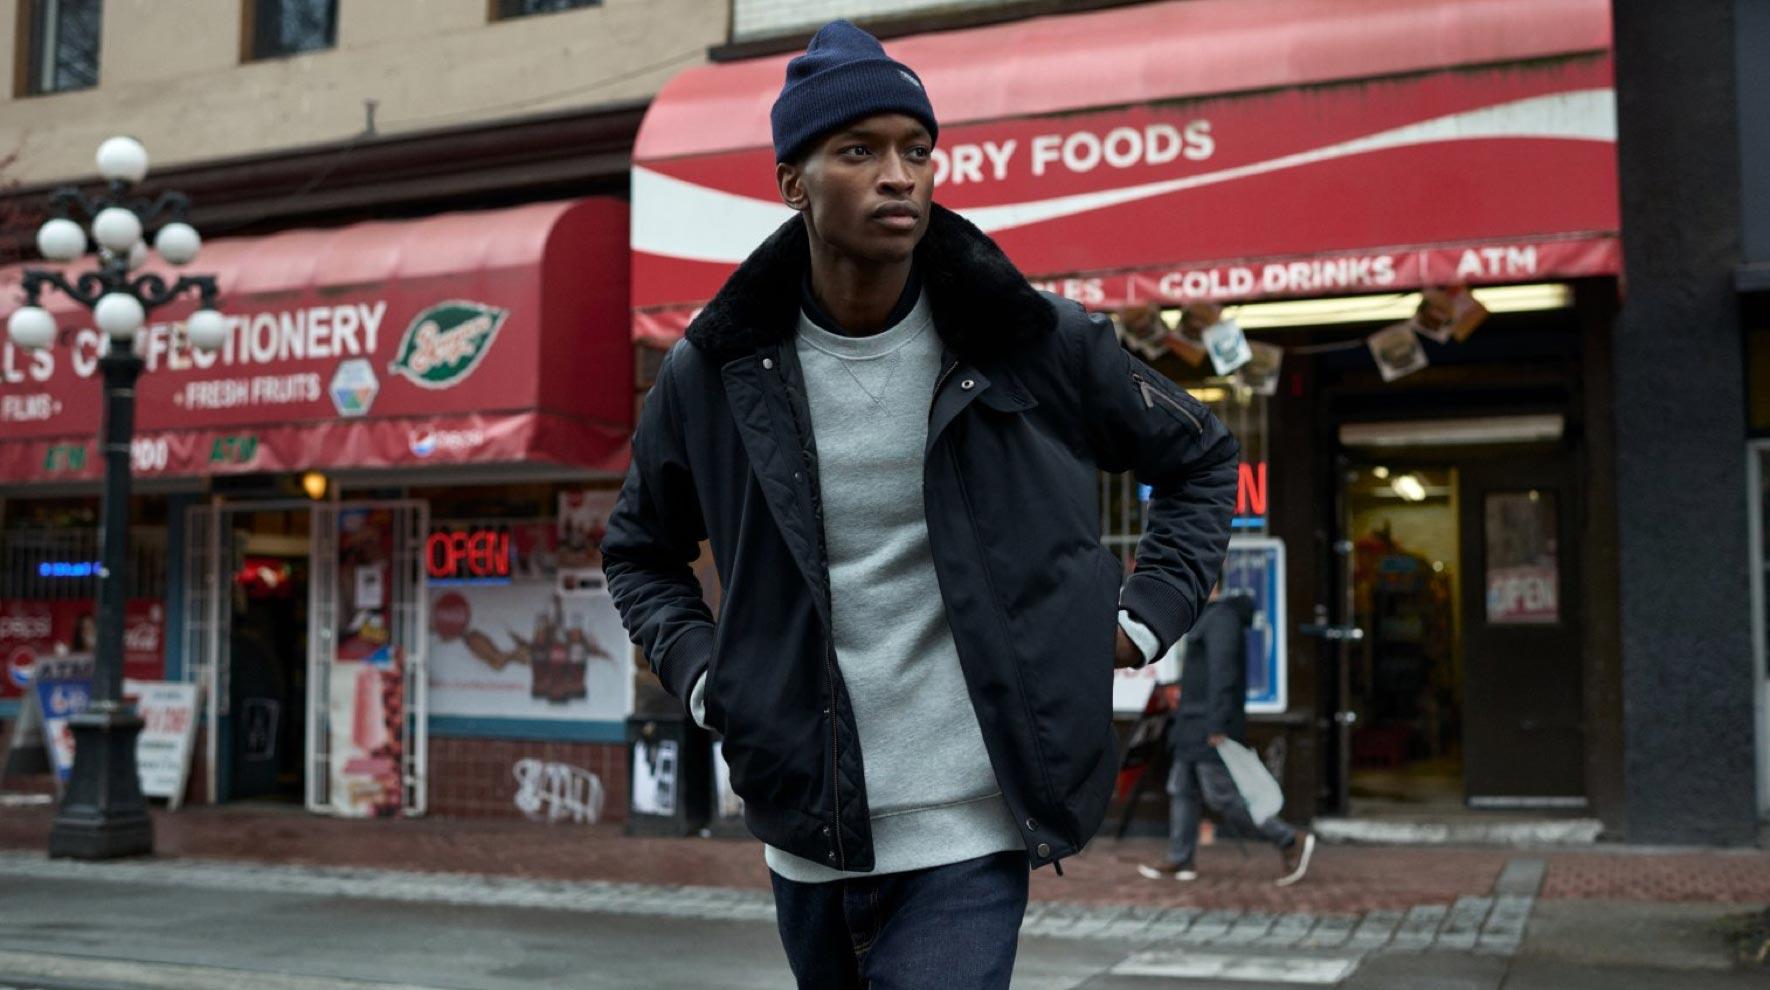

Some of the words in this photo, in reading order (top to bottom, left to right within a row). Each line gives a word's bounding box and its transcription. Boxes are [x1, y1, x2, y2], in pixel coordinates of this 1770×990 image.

[1031, 120, 1215, 177] FOODS
[1158, 266, 1254, 299] COLD
[1262, 255, 1396, 293] DRINKS
[1456, 245, 1538, 278] ATM
[71, 300, 388, 378] CFETIONERY
[184, 378, 249, 410] FRESH
[250, 372, 321, 405] FRUITS
[426, 530, 511, 578] OPEN
